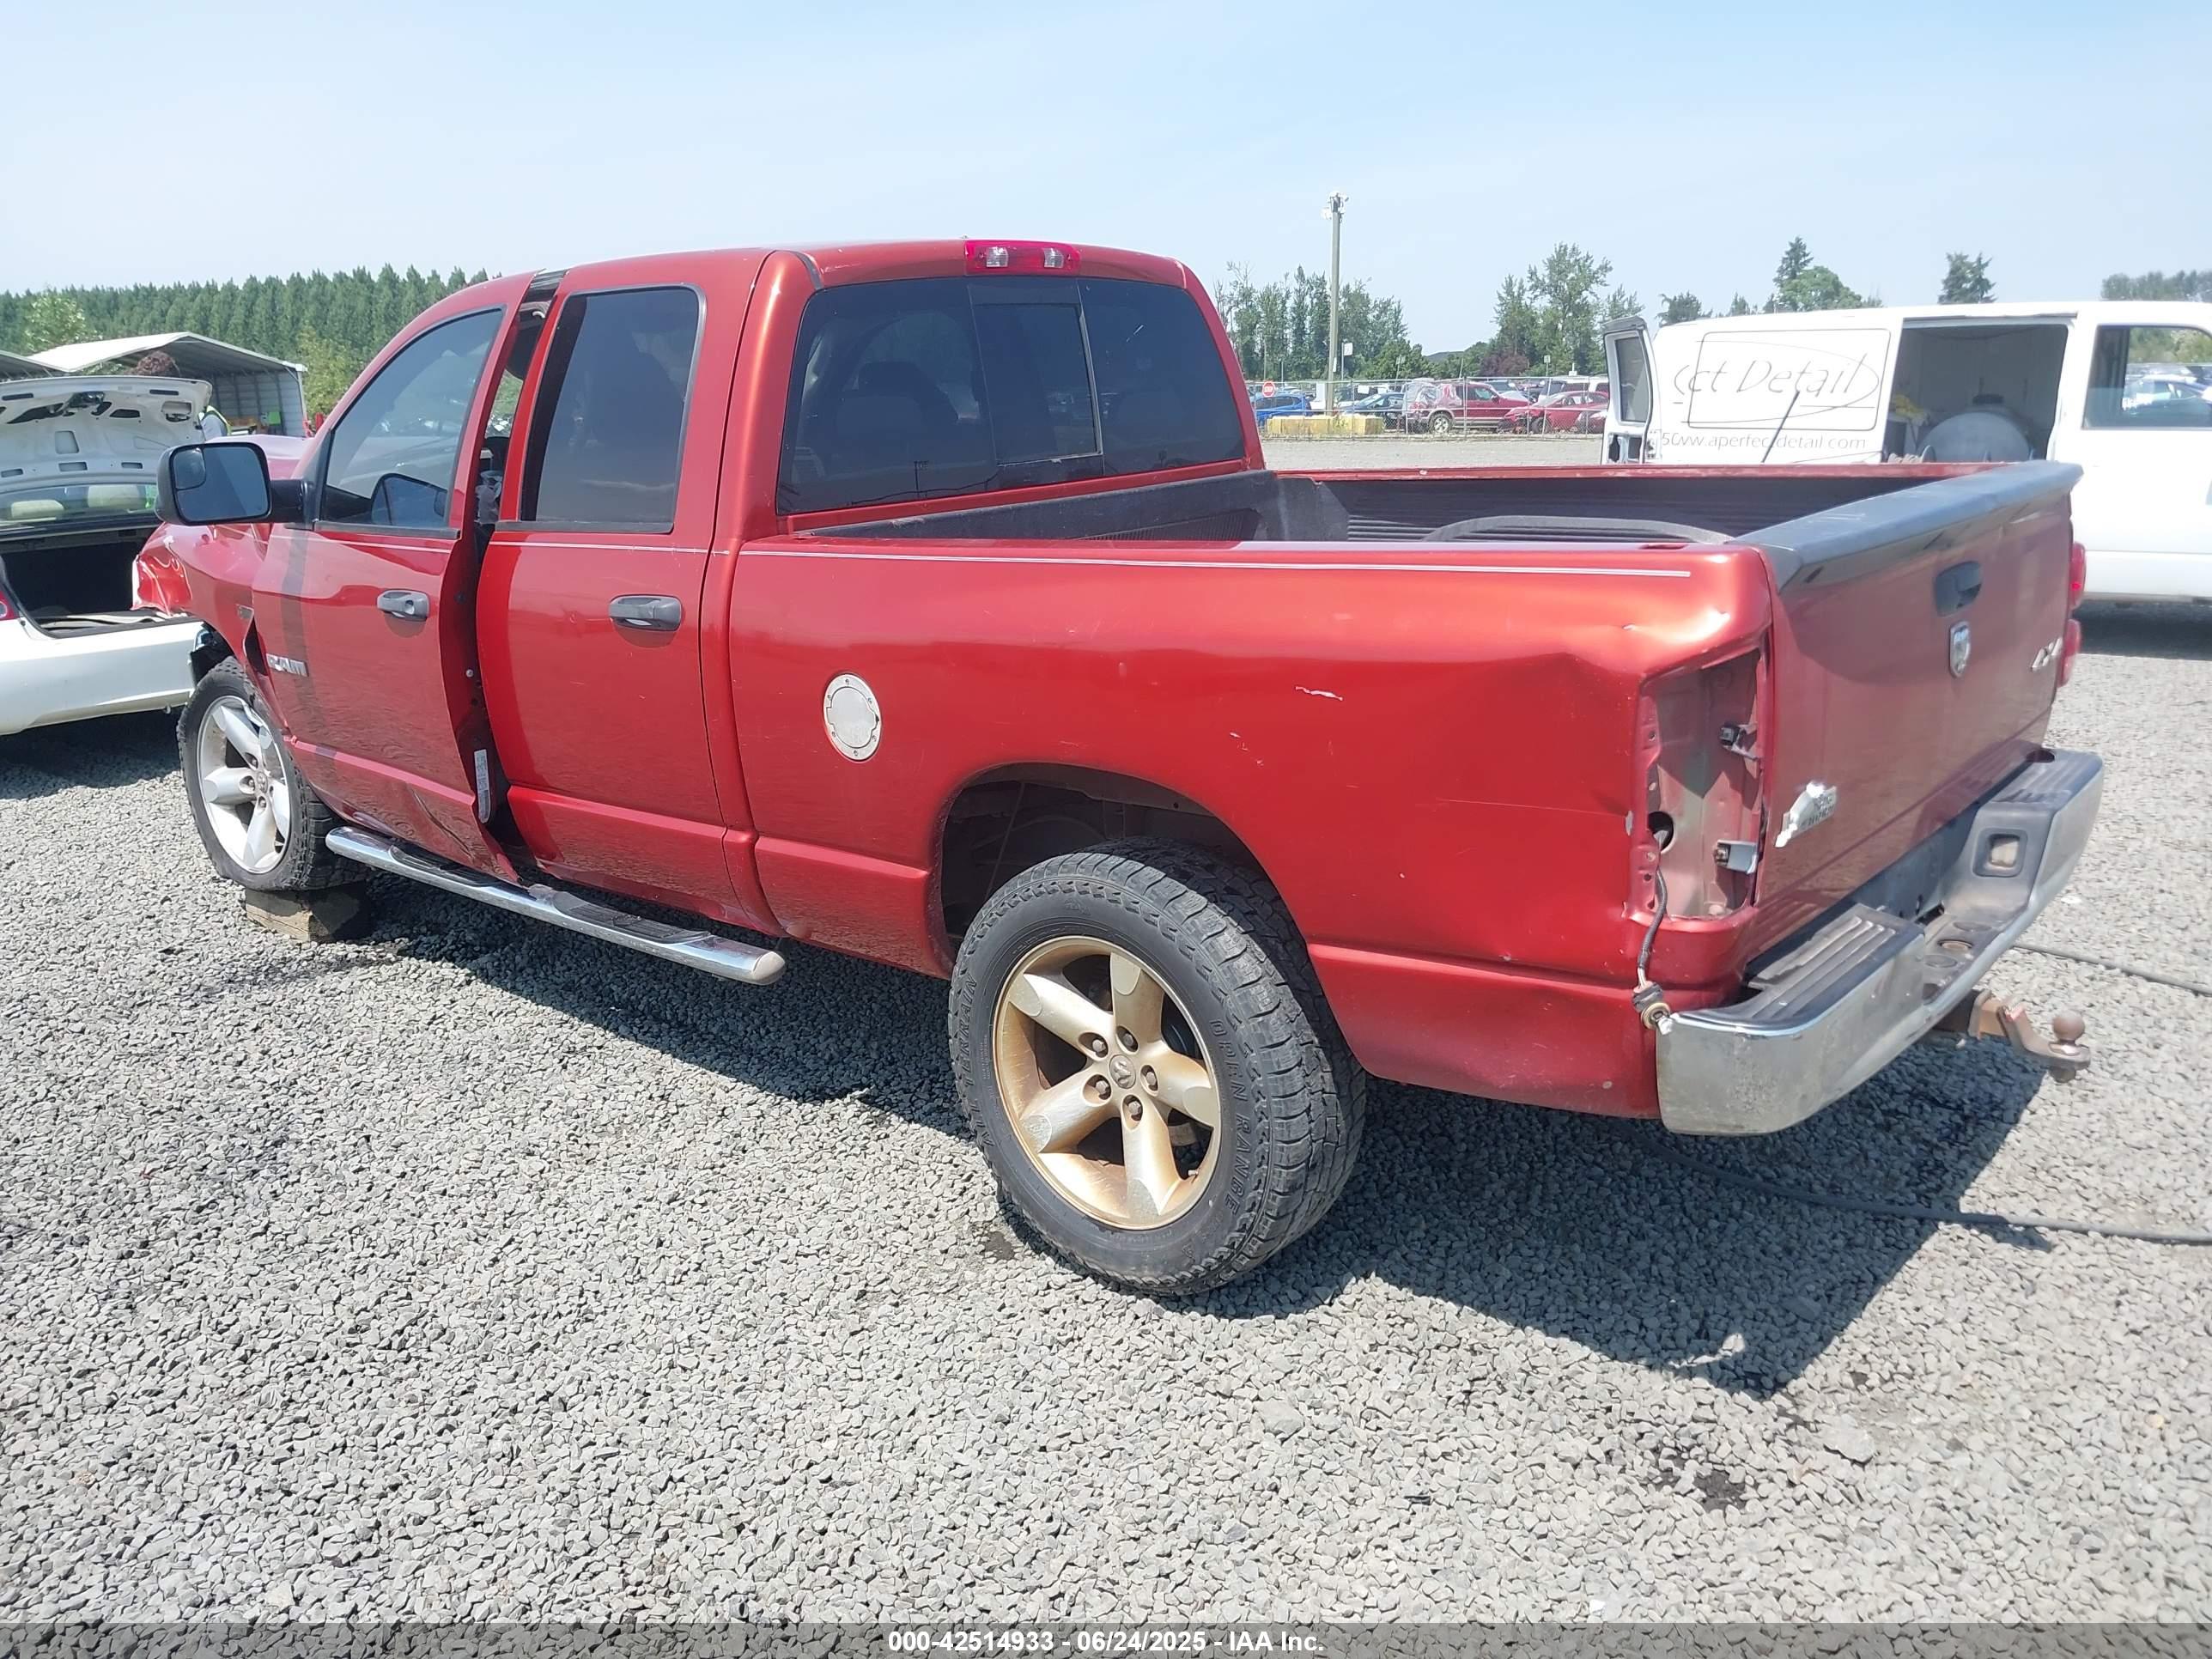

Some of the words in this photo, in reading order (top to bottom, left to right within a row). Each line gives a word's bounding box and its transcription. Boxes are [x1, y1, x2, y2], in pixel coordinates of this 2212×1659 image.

[1736, 355, 1867, 398] Detail
[1209, 1019, 1248, 1101] OPEN
[1225, 1113, 1251, 1214] RANGE
